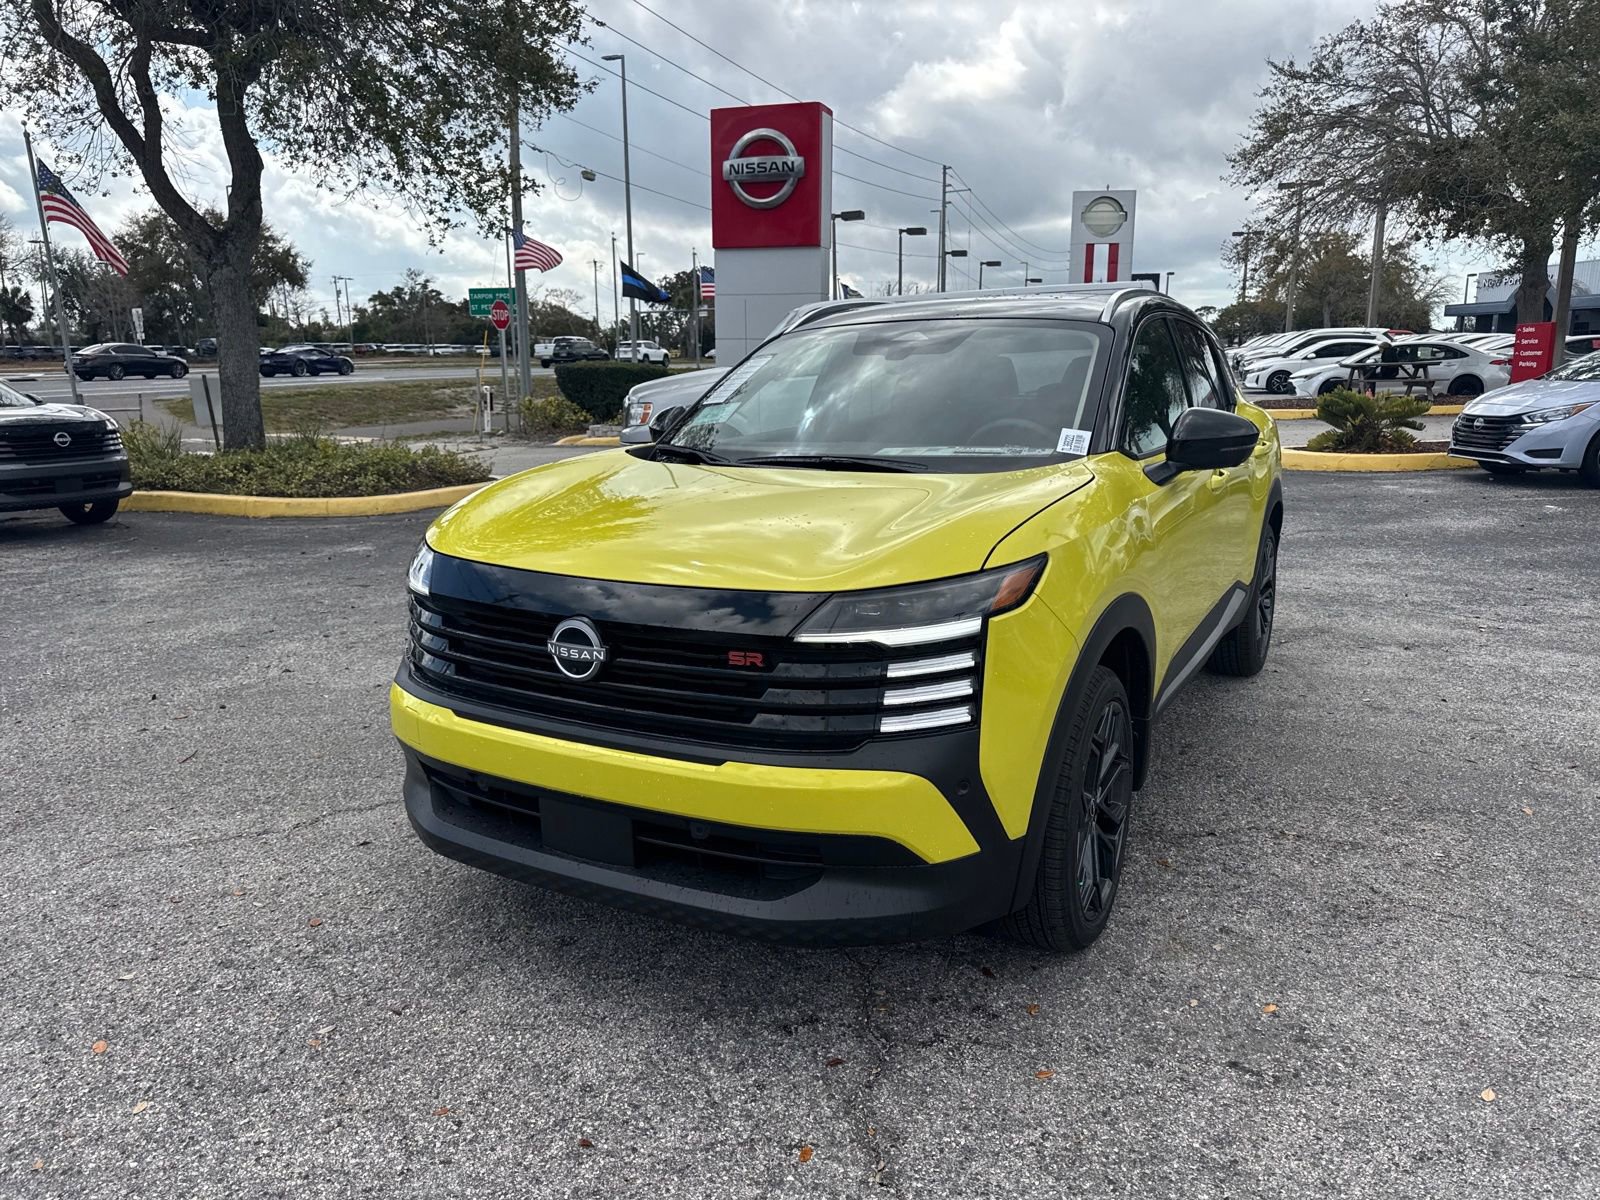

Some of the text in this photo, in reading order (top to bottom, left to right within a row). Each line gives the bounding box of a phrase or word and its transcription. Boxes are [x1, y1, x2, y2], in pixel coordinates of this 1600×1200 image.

[729, 161, 795, 175] NISSAN
[492, 310, 508, 320] STOP
[547, 643, 604, 661] NISSAN
[728, 651, 764, 667] SR
